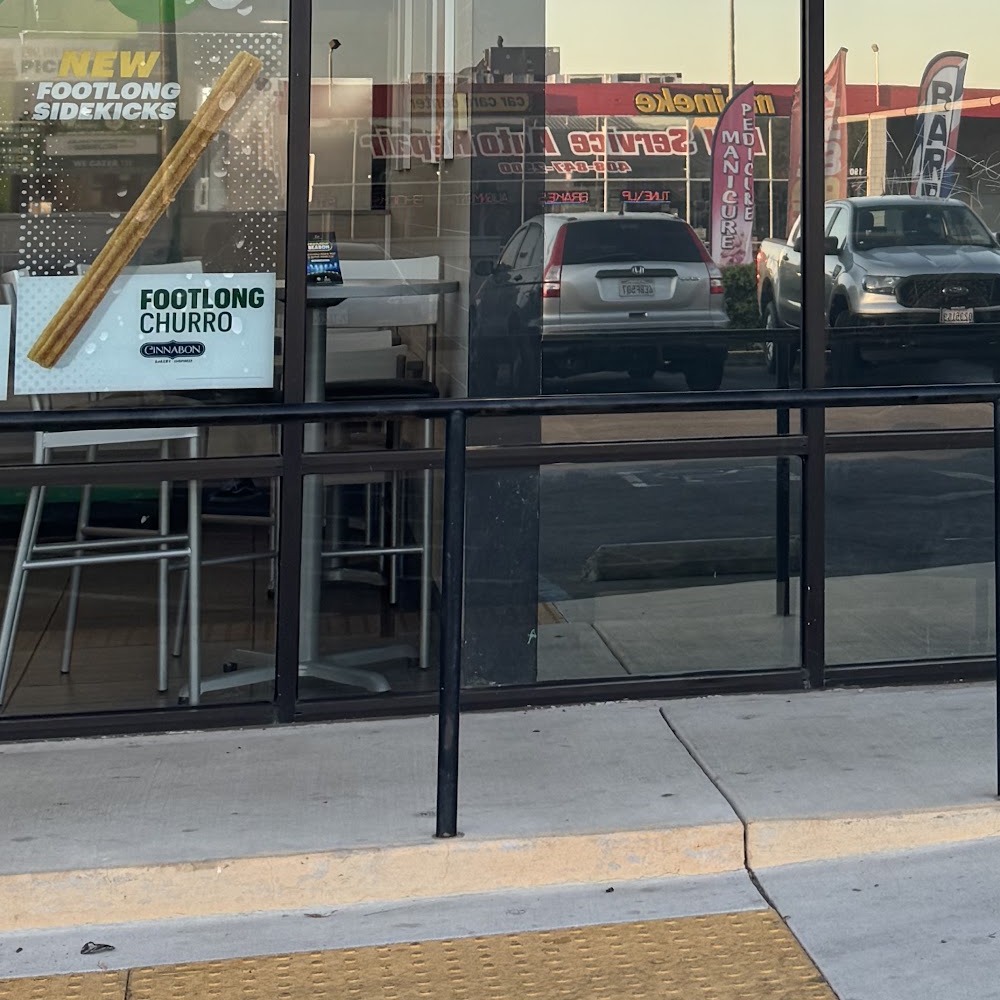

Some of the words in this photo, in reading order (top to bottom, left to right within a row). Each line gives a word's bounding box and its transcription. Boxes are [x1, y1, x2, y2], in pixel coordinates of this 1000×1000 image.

[58, 51, 161, 78] NEW
[36, 82, 181, 100] FOOTLONG
[33, 102, 177, 120] SIDEKICKS
[720, 130, 740, 250] MANICURE
[140, 287, 264, 310] FOOTLONG
[140, 311, 232, 333] CHURRO
[144, 345, 201, 355] CINNABON
